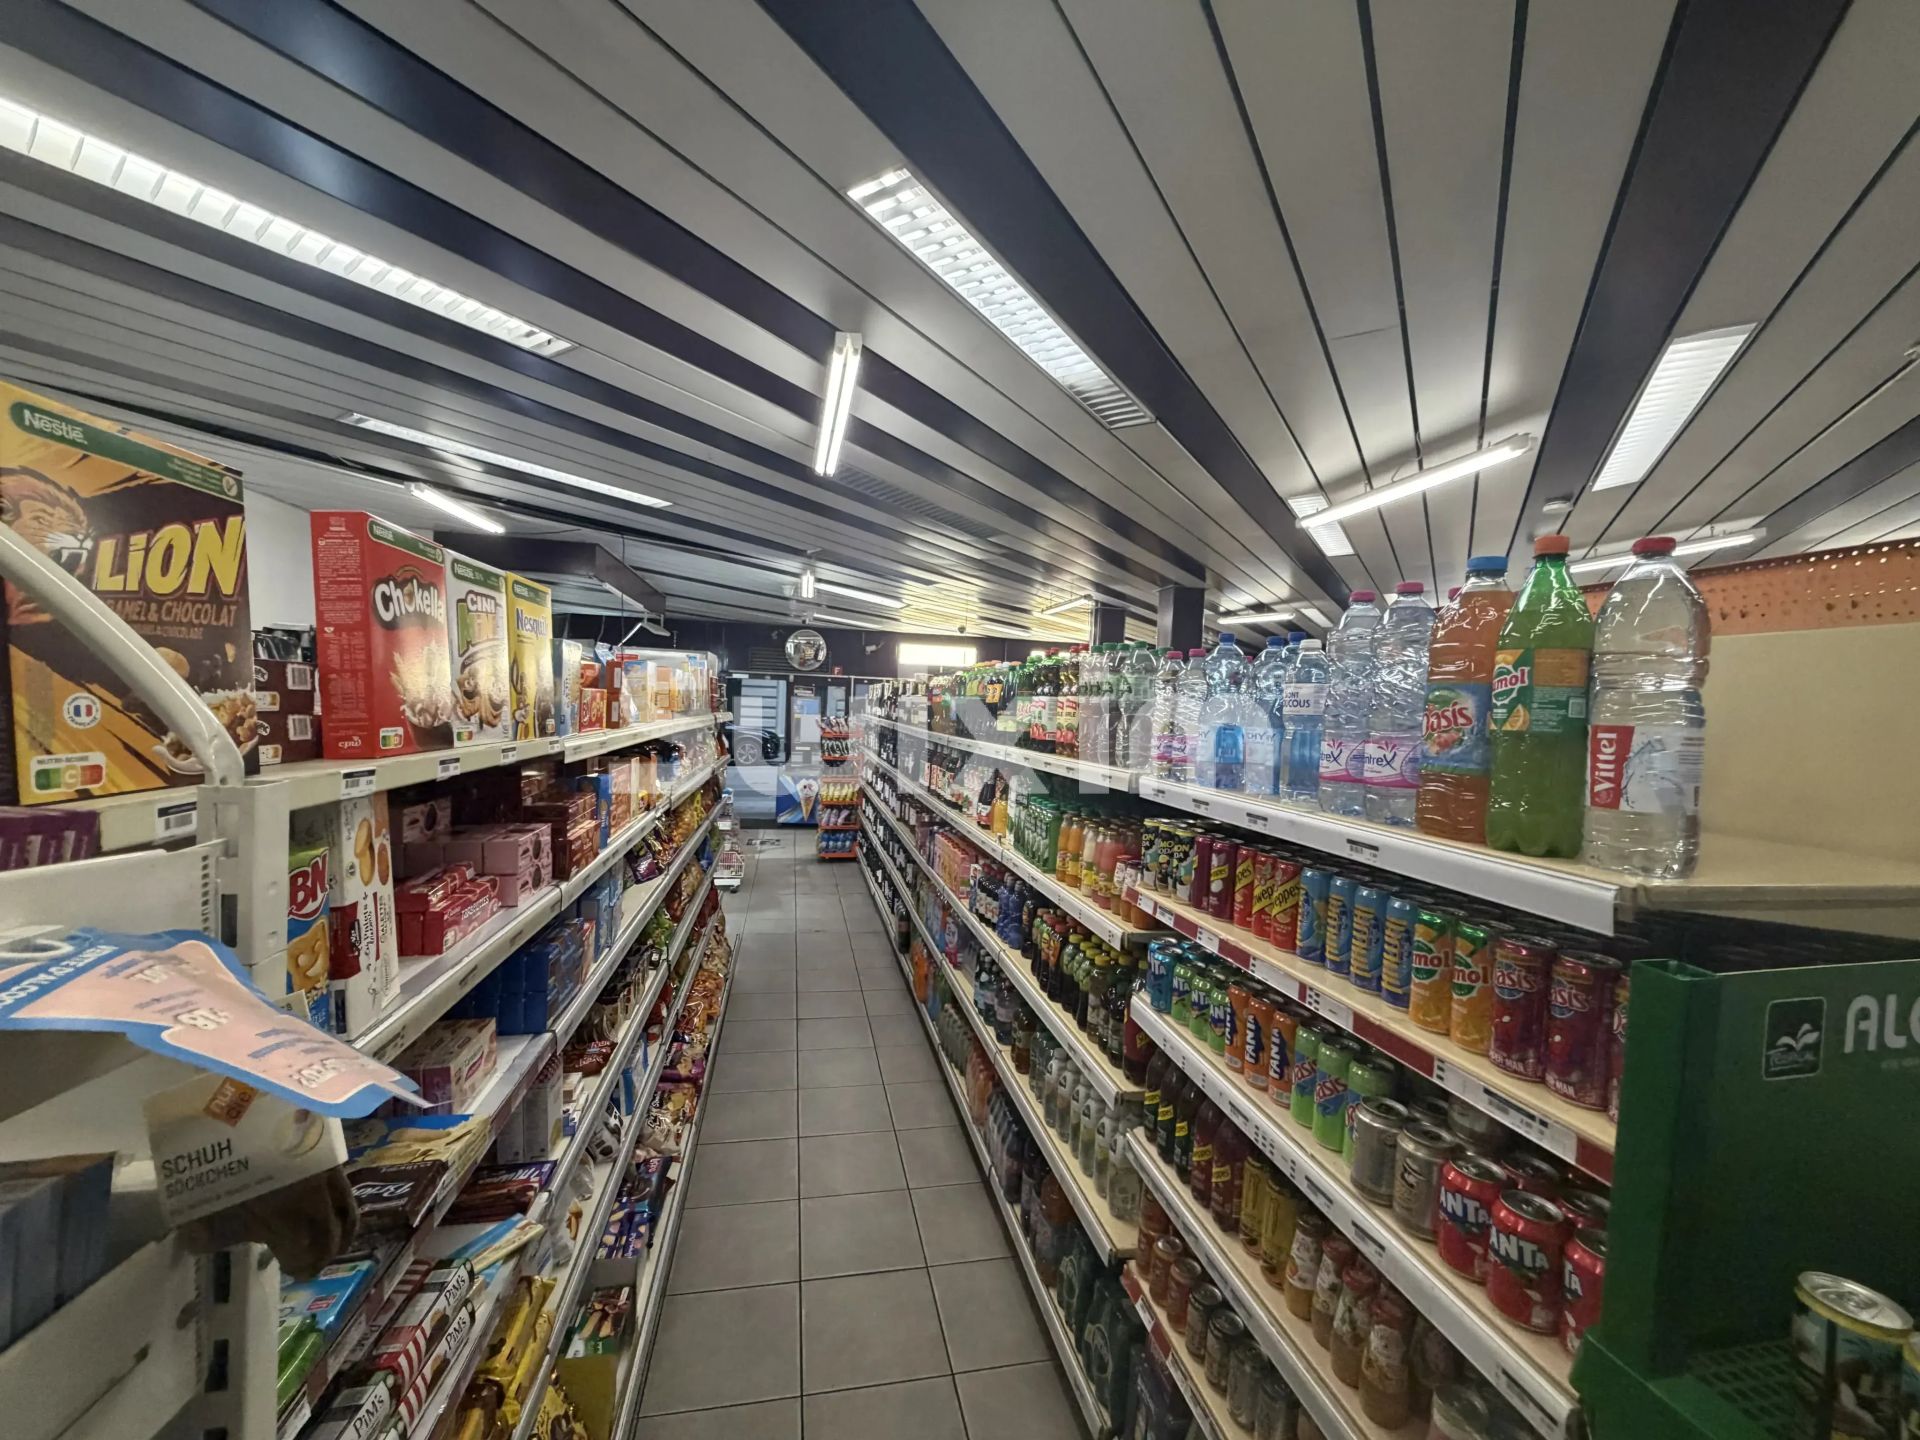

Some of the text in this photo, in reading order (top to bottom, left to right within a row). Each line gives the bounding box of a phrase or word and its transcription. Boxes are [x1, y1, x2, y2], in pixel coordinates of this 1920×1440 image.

[161, 601, 237, 627] CHOCOLAT
[466, 592, 497, 614] CINI
[1593, 732, 1617, 793] Vittel
[288, 852, 329, 908] BN
[1412, 951, 1449, 968] mol
[1453, 966, 1490, 985] mol
[1172, 976, 1191, 992] NTA
[1497, 970, 1537, 993] asis
[1245, 1014, 1257, 1064] FANTA
[1269, 1028, 1281, 1080] FANTA
[212, 1081, 236, 1113] nur
[161, 1138, 233, 1179] SCHUH
[165, 1156, 250, 1200] SÖCKCHEN
[1440, 1185, 1492, 1225] ANTA
[1489, 1224, 1550, 1270] ANTA
[352, 1393, 384, 1439] PiM's
